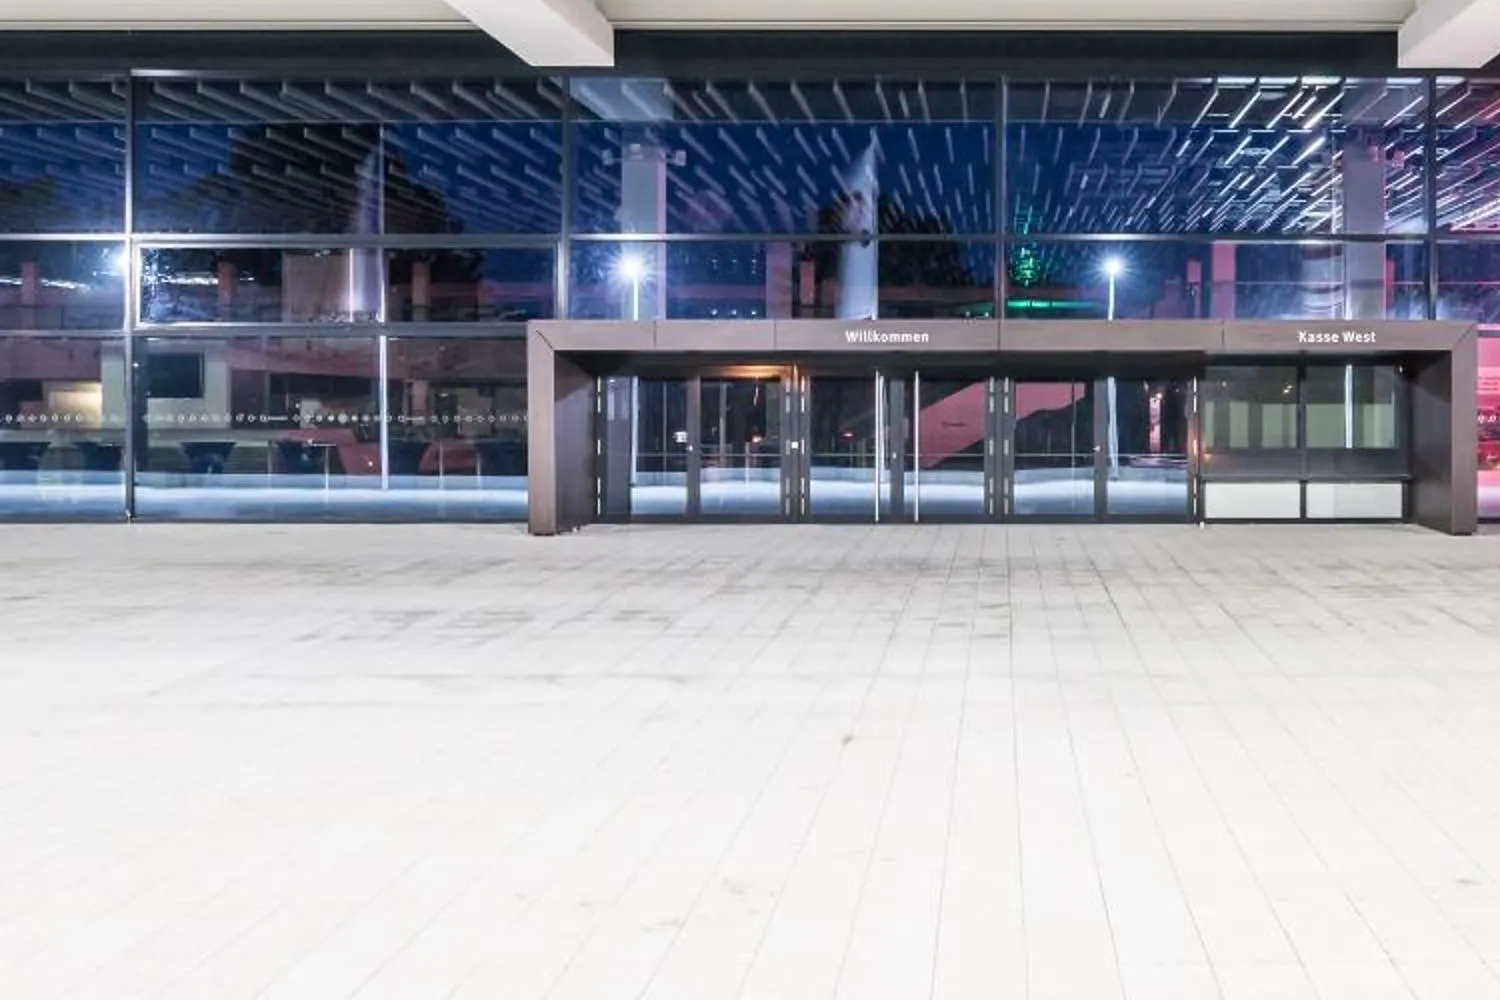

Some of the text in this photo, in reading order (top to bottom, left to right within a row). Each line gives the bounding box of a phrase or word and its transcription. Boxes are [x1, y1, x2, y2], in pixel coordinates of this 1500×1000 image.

[845, 329, 929, 343] Willkommen
[1298, 330, 1376, 343] Kasse West
